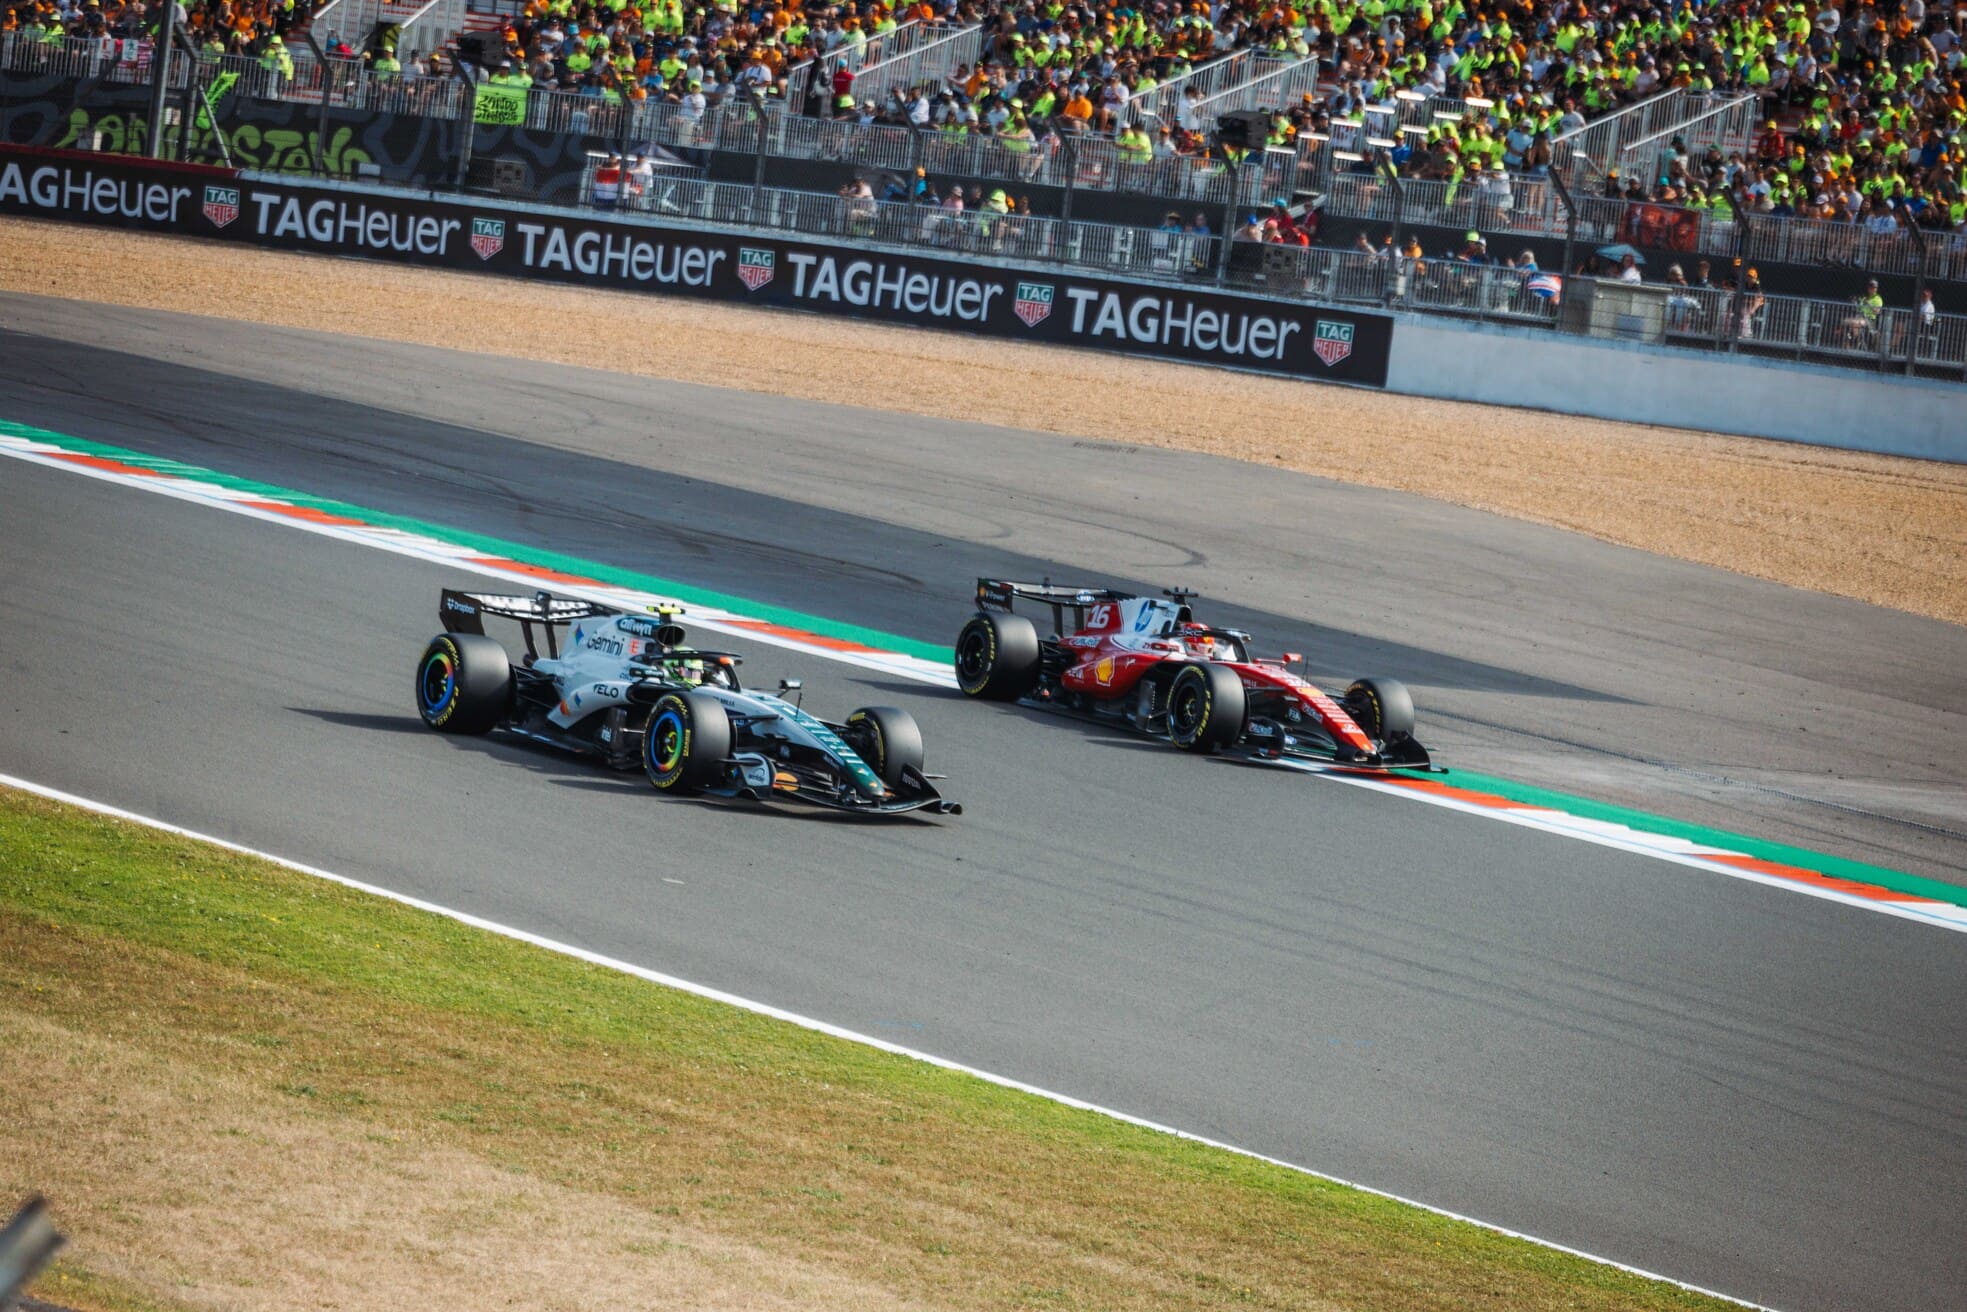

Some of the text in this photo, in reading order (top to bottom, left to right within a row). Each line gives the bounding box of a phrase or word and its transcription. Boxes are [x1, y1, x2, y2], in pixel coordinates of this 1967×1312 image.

[0, 163, 192, 222] AGHeuer
[209, 190, 237, 204] TAG
[205, 203, 239, 225] HEUER
[476, 221, 502, 236] TAG
[472, 236, 503, 257] HEUER
[743, 250, 772, 266] TAG
[740, 267, 773, 288] HEUER
[1021, 285, 1050, 301] TAG
[1016, 302, 1050, 324] HEUER
[1320, 323, 1350, 340] TAG
[1315, 341, 1351, 362] HEUER
[1087, 604, 1111, 629] 16
[586, 631, 624, 656] Gemini
